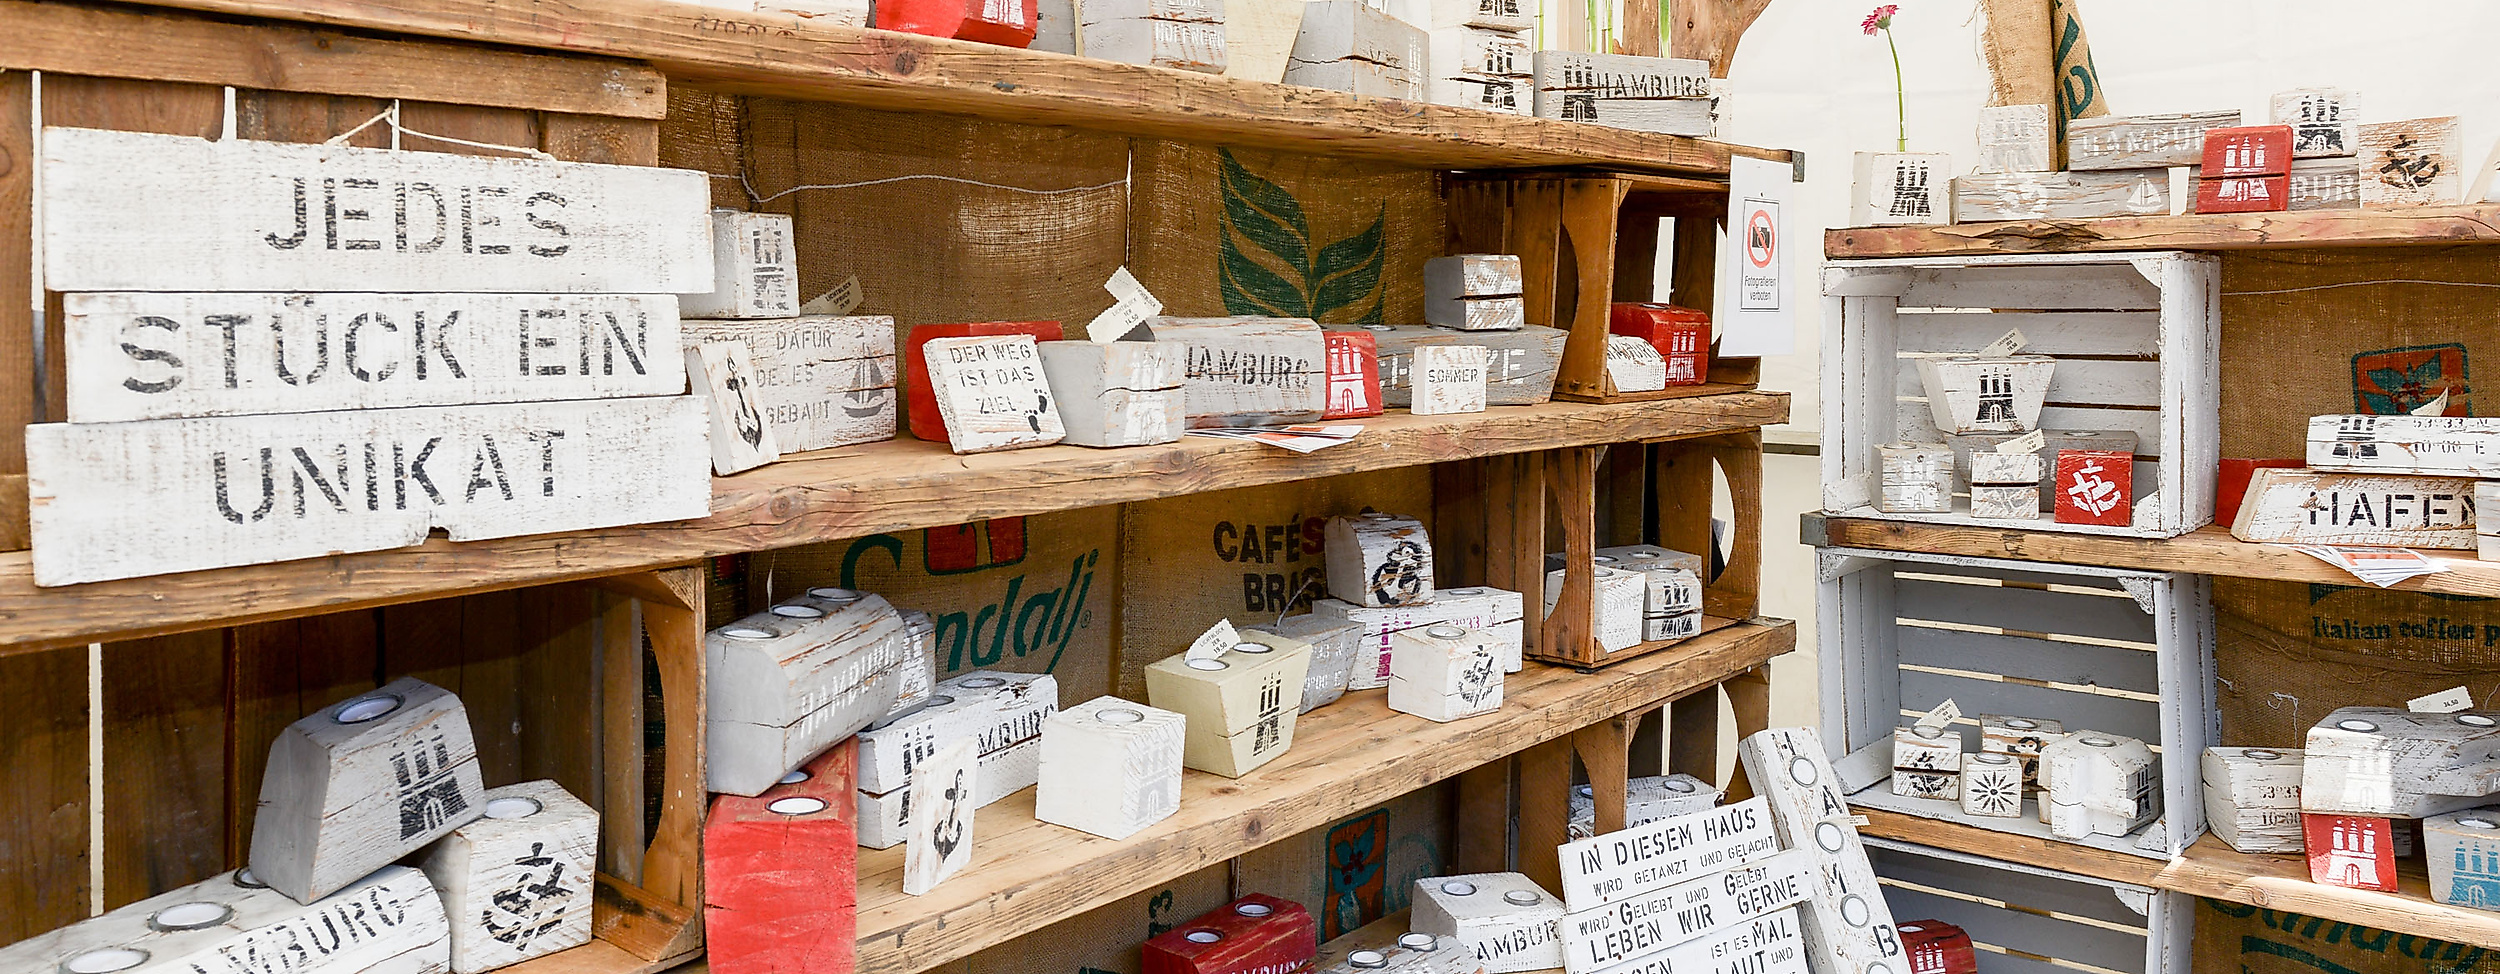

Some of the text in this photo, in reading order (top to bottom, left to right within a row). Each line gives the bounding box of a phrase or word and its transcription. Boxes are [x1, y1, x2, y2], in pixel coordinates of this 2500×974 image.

[1597, 72, 1708, 97] HAMBURG
[2082, 125, 2206, 157] HAMBU
[264, 176, 570, 258] JEDES
[1744, 275, 1776, 288] Fotografieren
[1749, 290, 1771, 301] verboten
[1111, 297, 1136, 316] LICHTBLOCK
[121, 294, 648, 394] STÜCK EIN
[776, 327, 832, 350] DAFÜR
[949, 343, 1031, 364] DER WEG
[959, 366, 1035, 388] IST DAS
[1428, 369, 1478, 384] SOMMER
[976, 395, 1017, 415] ZIEL
[213, 429, 565, 525] UNIKAT
[2310, 491, 2476, 528] HAFEN
[1213, 513, 1325, 564] CAFÉS
[1244, 567, 1324, 613] BRAS
[1200, 626, 1224, 647] LICHTBLOCK
[2312, 616, 2392, 640] Italian
[2400, 618, 2475, 640] coffee
[800, 637, 895, 738] HAMBURG
[1580, 847, 1602, 875] IN
[1614, 824, 1693, 866] DIESEM
[1704, 808, 1757, 841] HAUS
[1593, 836, 1774, 897] WIRD GETANZT UND GELACHT
[1579, 916, 1610, 936] WIRD
[1686, 886, 1709, 903] UND
[1590, 874, 1799, 964] LEBEN WIR GERNE
[1476, 920, 1559, 961] AMBUR
[1711, 917, 1793, 959] IST ES MAL
[1715, 946, 1794, 974] AUT UND
